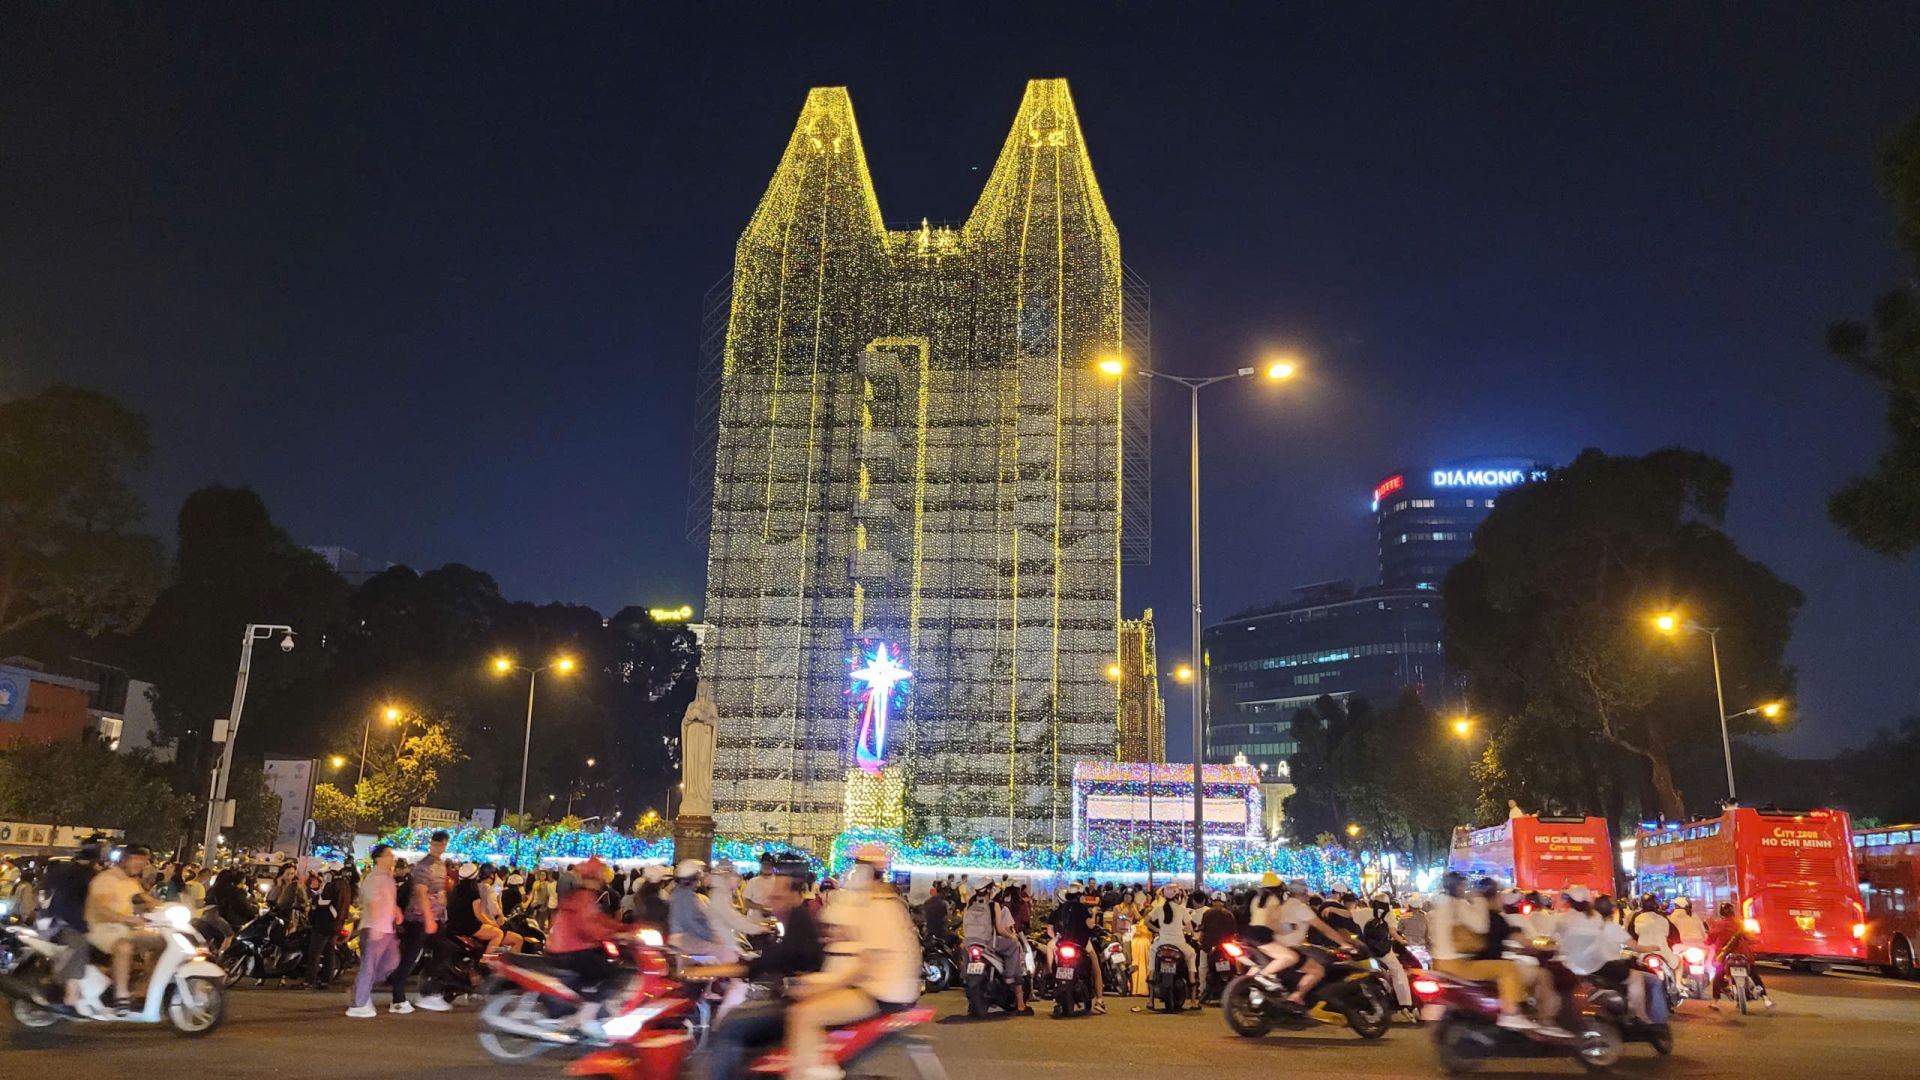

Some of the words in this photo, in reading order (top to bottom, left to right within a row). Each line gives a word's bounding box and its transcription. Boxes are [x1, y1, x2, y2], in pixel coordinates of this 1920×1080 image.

[1434, 470, 1525, 486] DIAMOND
[1378, 476, 1401, 496] LOTTE
[1534, 835, 1549, 843] HO
[1551, 836, 1568, 844] CHI
[1761, 838, 1778, 846] HO
[1780, 838, 1800, 847] CHI
[1803, 839, 1832, 848] MINH
